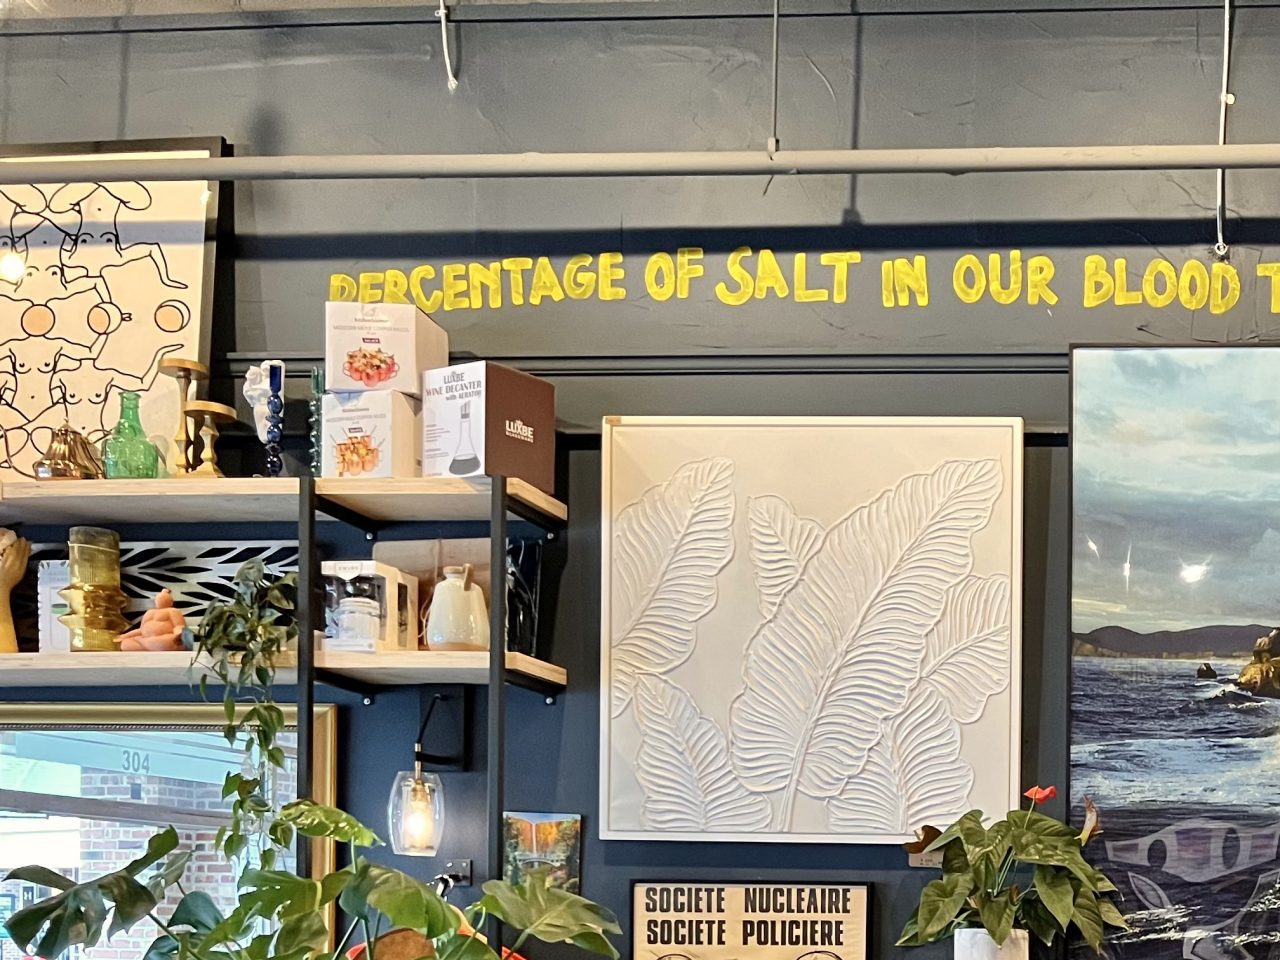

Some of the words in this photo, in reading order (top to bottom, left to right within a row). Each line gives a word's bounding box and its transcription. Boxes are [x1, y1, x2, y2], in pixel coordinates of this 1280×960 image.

[329, 253, 625, 313] PERCENTAGE
[645, 247, 704, 302] OF
[715, 246, 862, 307] SALT
[882, 255, 930, 309] IN
[952, 250, 1059, 306] OUR
[1083, 254, 1242, 316] BLOOD
[426, 386, 443, 396] WINE
[445, 380, 482, 394] DECANTER
[505, 419, 534, 439] LUXBE
[122, 750, 150, 774] 304
[645, 887, 725, 913] SOCIETE
[744, 887, 851, 914] NUCLEAIRE
[646, 919, 726, 945] SOCIETE
[742, 920, 844, 946] POLICIERE
